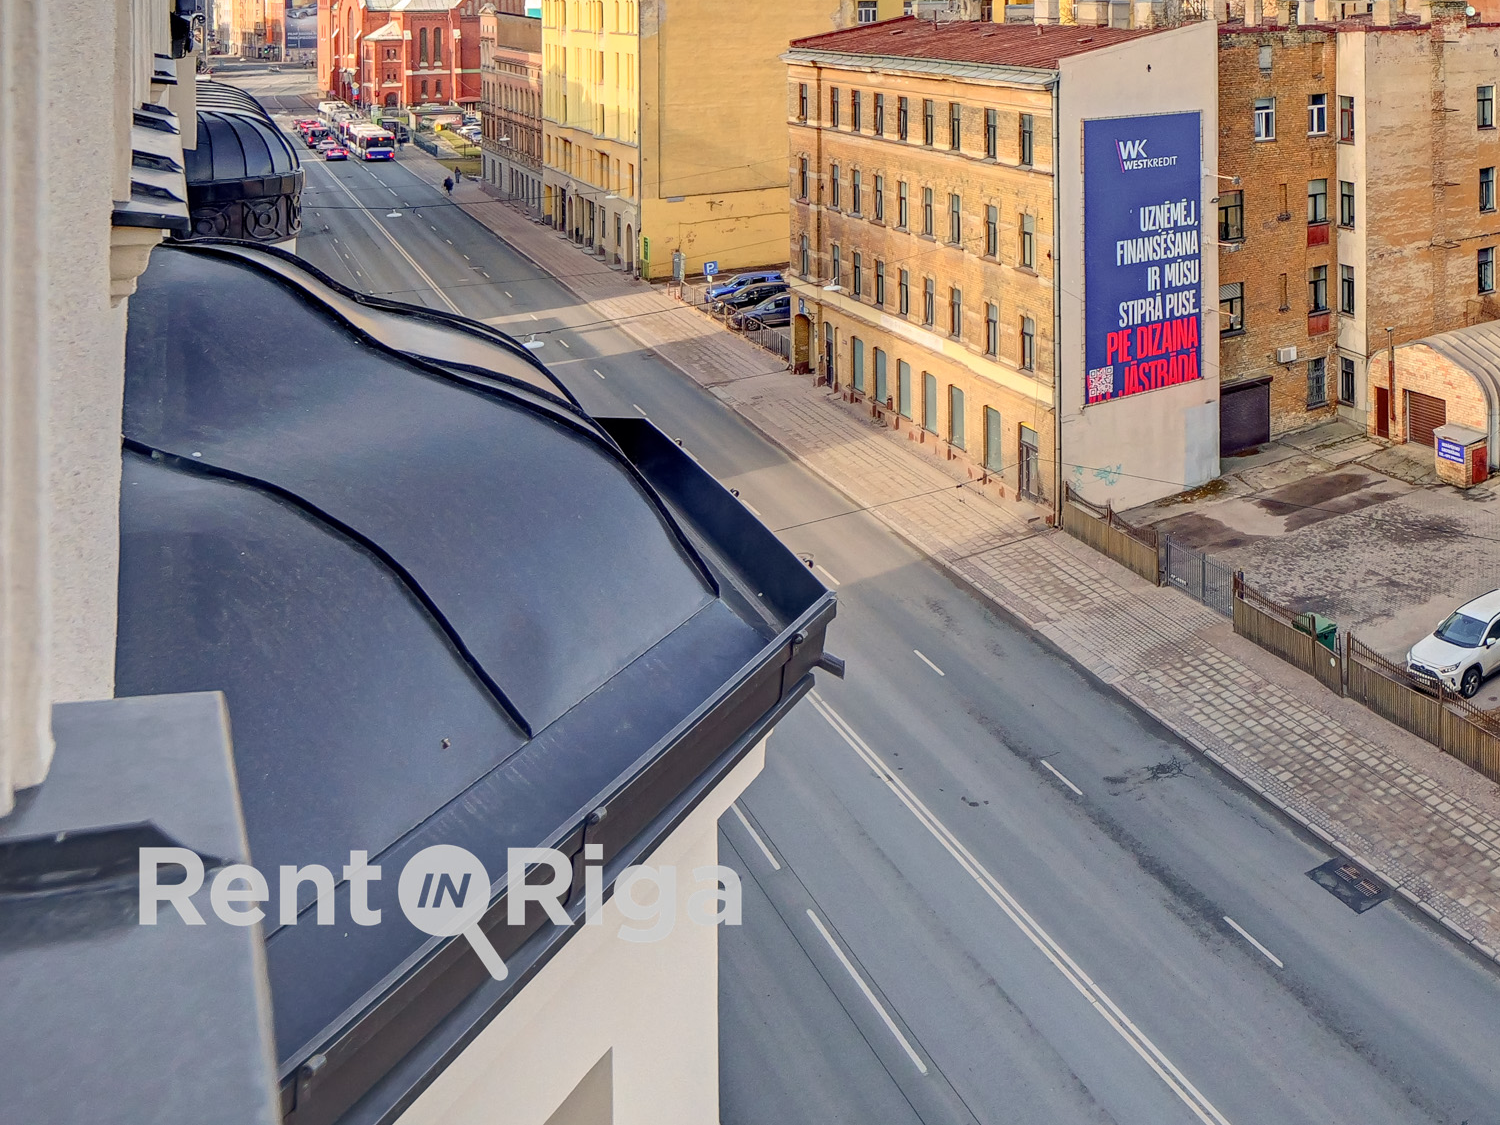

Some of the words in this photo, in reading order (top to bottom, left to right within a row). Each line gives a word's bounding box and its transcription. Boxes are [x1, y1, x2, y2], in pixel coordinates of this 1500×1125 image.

[1119, 139, 1148, 160] WK
[1123, 156, 1178, 171] WESTKREDIT
[1140, 198, 1199, 233] UZŅĒMĒJ,
[1116, 230, 1199, 266] FINANSĒŠANA
[1147, 266, 1161, 292] IR
[1164, 259, 1200, 289] MŪSU
[1118, 292, 1164, 328] STIPRĀ
[1165, 289, 1200, 319] PUSE.
[1106, 329, 1132, 366] PIE
[1136, 316, 1199, 360] DIZAINA
